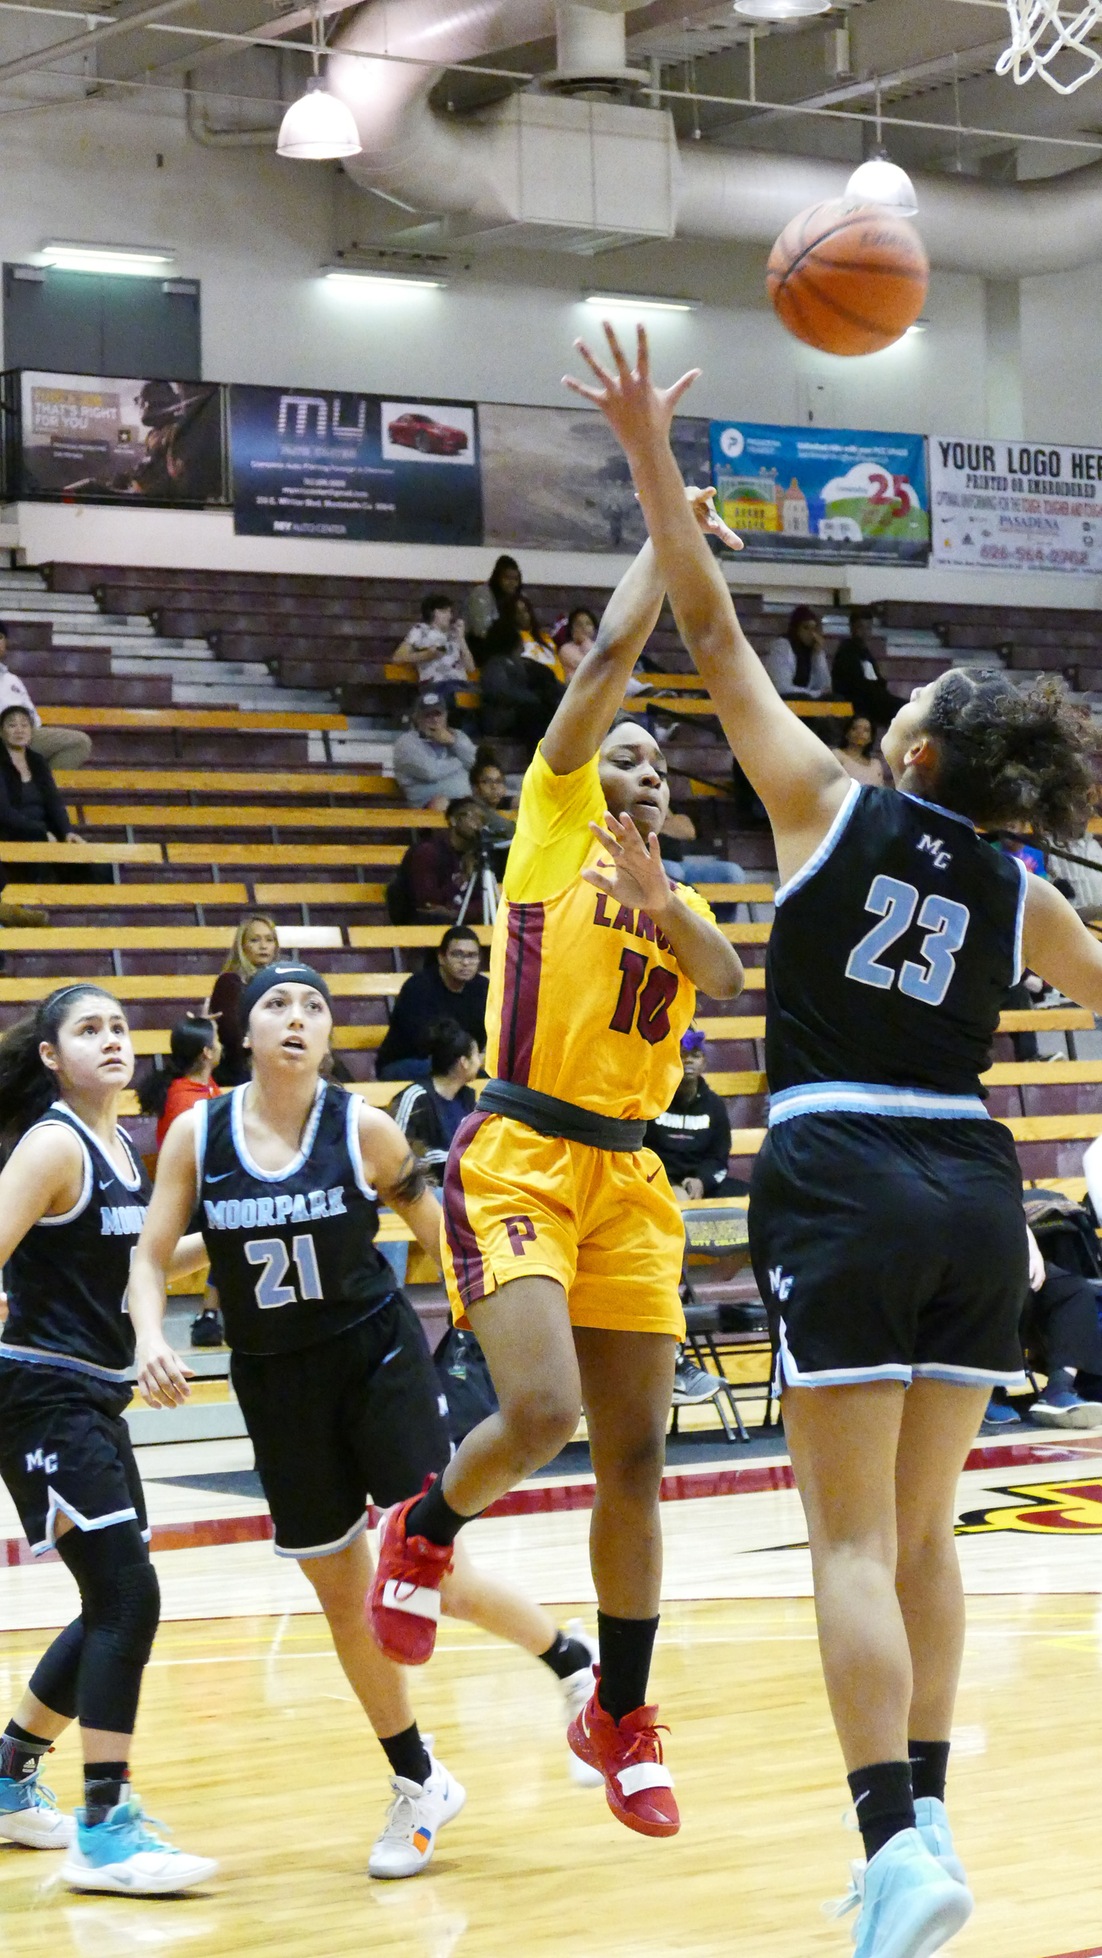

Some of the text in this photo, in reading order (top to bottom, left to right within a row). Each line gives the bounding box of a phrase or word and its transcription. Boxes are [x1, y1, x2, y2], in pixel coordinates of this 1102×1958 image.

[36, 414, 89, 430] FOR YOU
[81, 406, 119, 420] RIGHT
[938, 440, 996, 472] YOUR
[1007, 447, 1062, 478] LOGO
[868, 473, 911, 518] 25
[966, 473, 1096, 499] PRINTED OR EMBROIDERED
[999, 515, 1060, 530] PASADENA
[845, 873, 970, 1006] 23
[609, 947, 679, 1046] 10
[203, 1186, 348, 1230] MOORPARK
[499, 1215, 538, 1257] P
[690, 1239, 711, 1247] CITY
[244, 1234, 324, 1309] 21
[25, 1448, 59, 1475] MC
